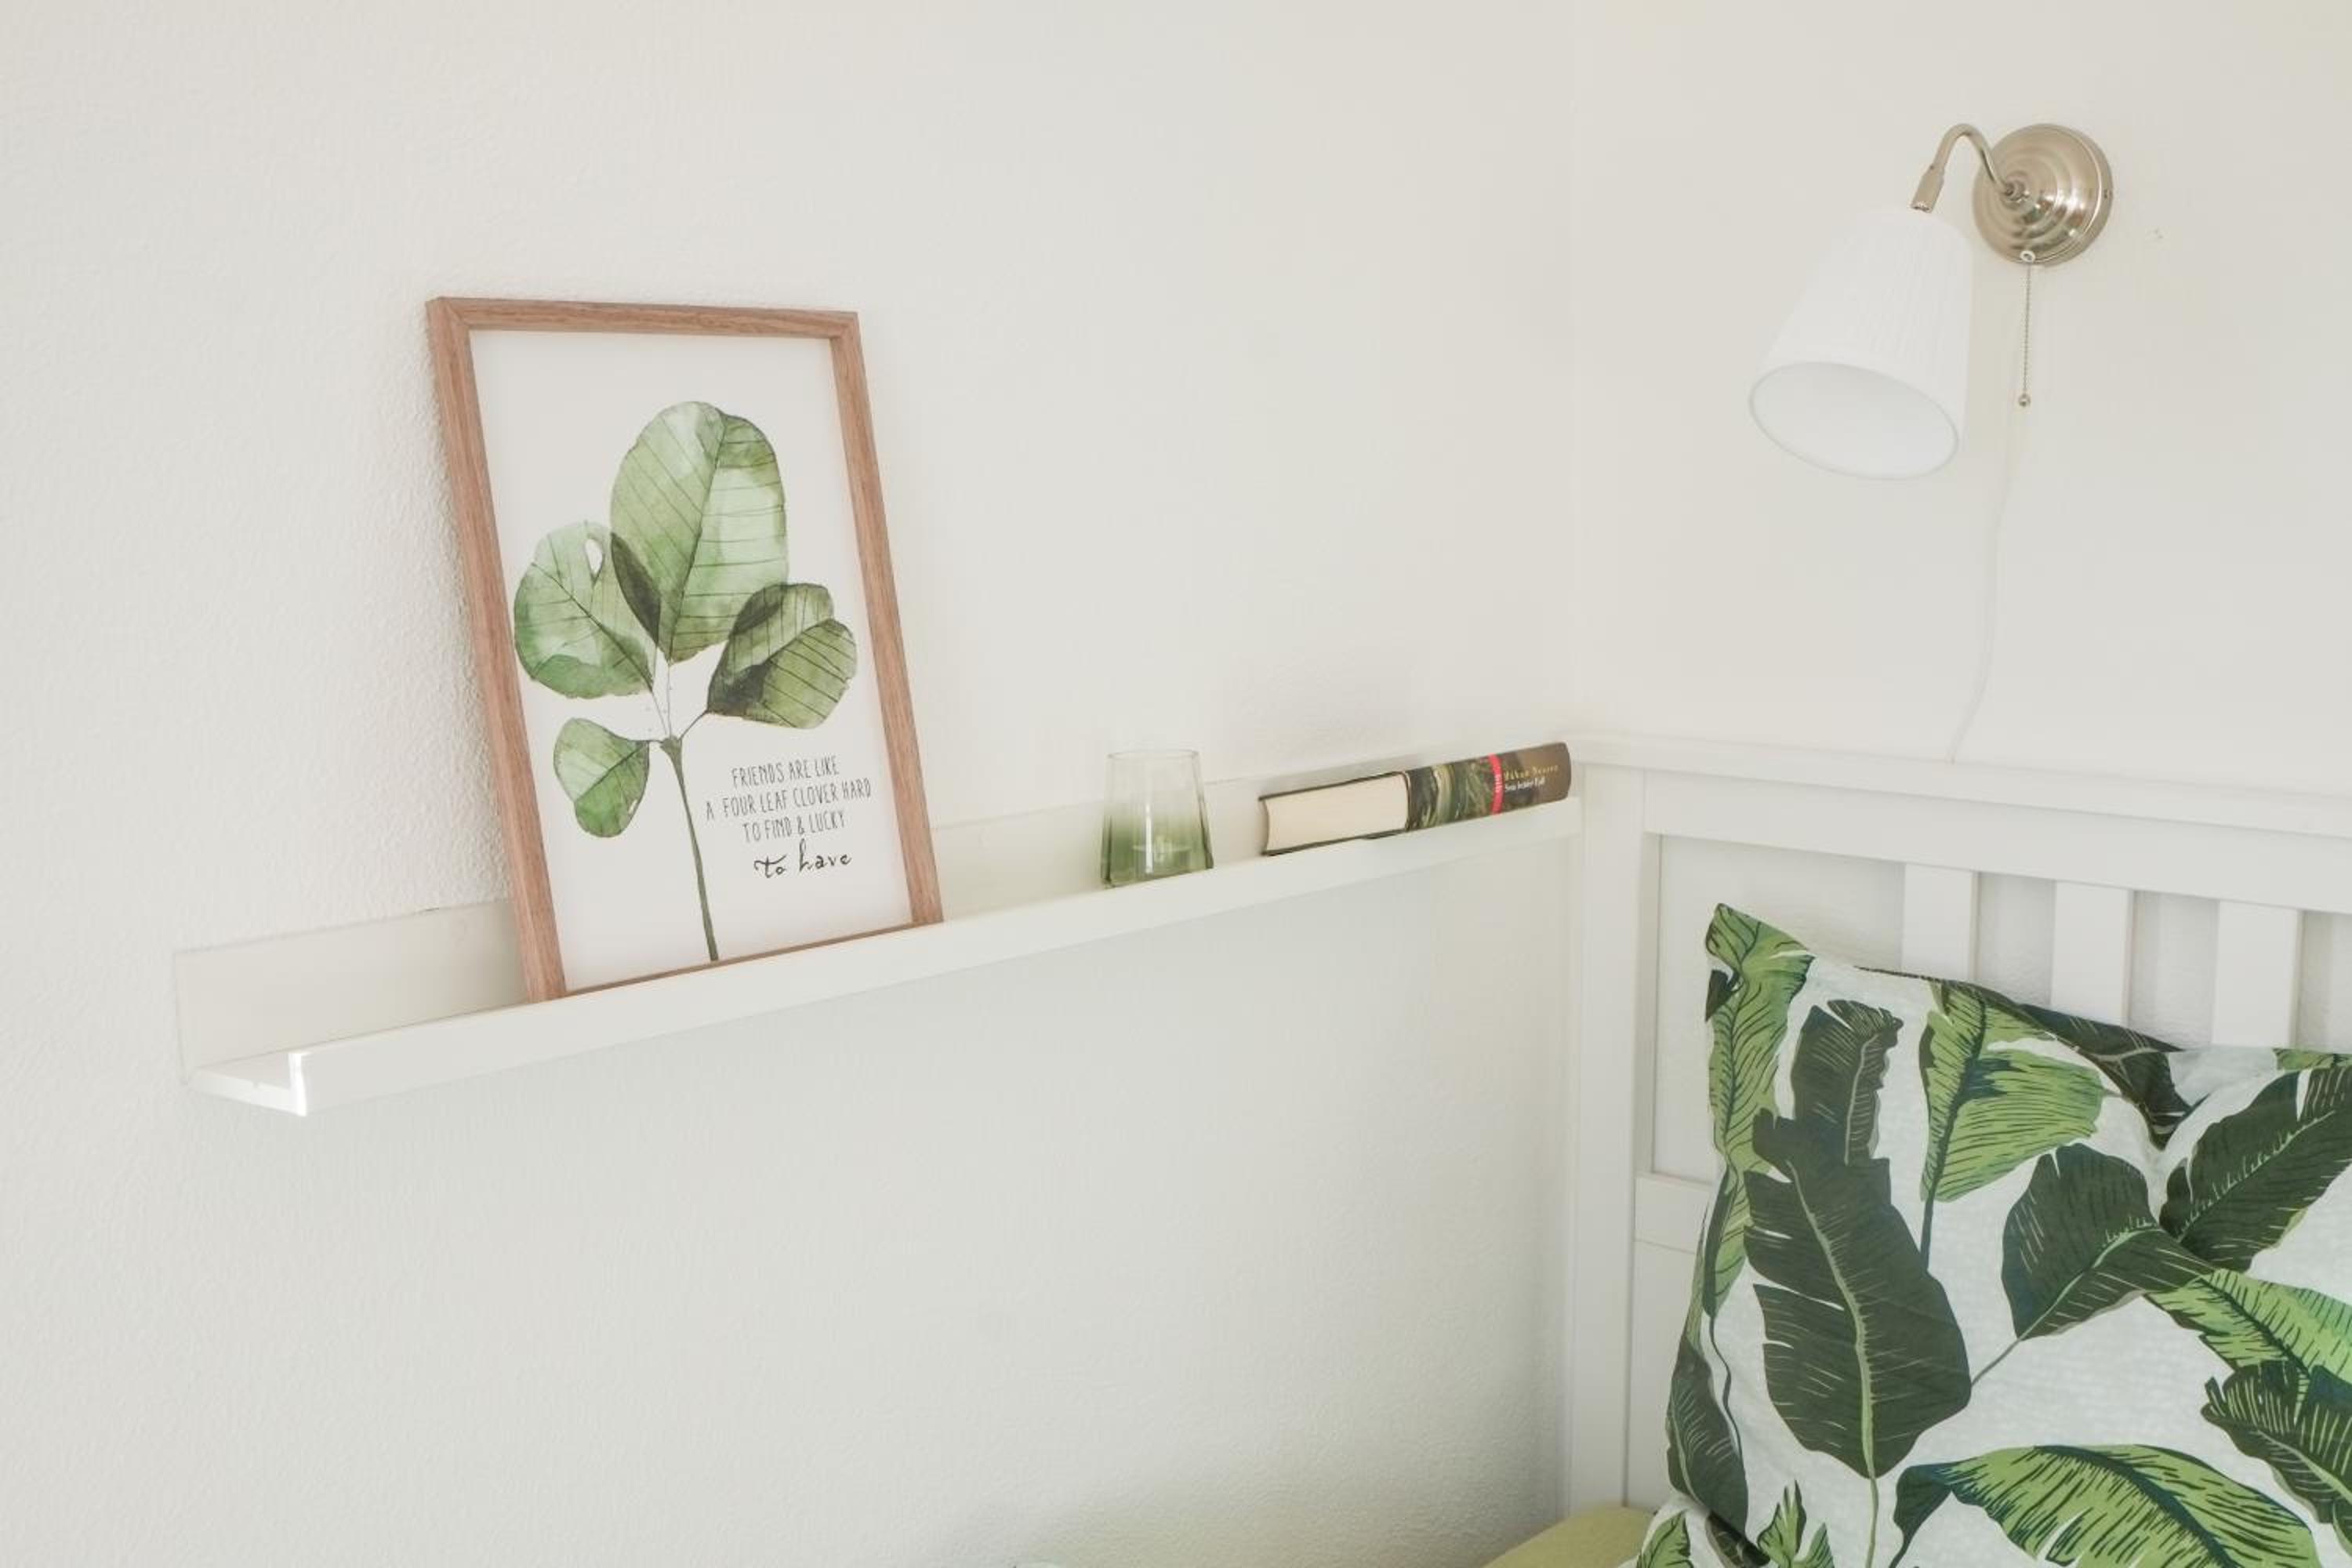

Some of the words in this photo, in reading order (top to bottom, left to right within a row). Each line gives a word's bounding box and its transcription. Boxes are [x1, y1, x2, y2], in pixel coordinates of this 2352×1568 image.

[731, 761, 785, 789] FRIENDS
[789, 758, 812, 780] ARE
[815, 755, 840, 778] LIKE
[706, 800, 715, 821] A
[722, 793, 757, 818] FOUR
[760, 789, 788, 813] LEAF
[793, 782, 839, 808] CLOVER
[841, 777, 872, 800] HARD
[742, 822, 761, 843] TO
[764, 816, 793, 840] FIND
[797, 815, 805, 835] &
[808, 810, 845, 833] LUCKY
[753, 853, 788, 878] to
[798, 838, 852, 873] have
